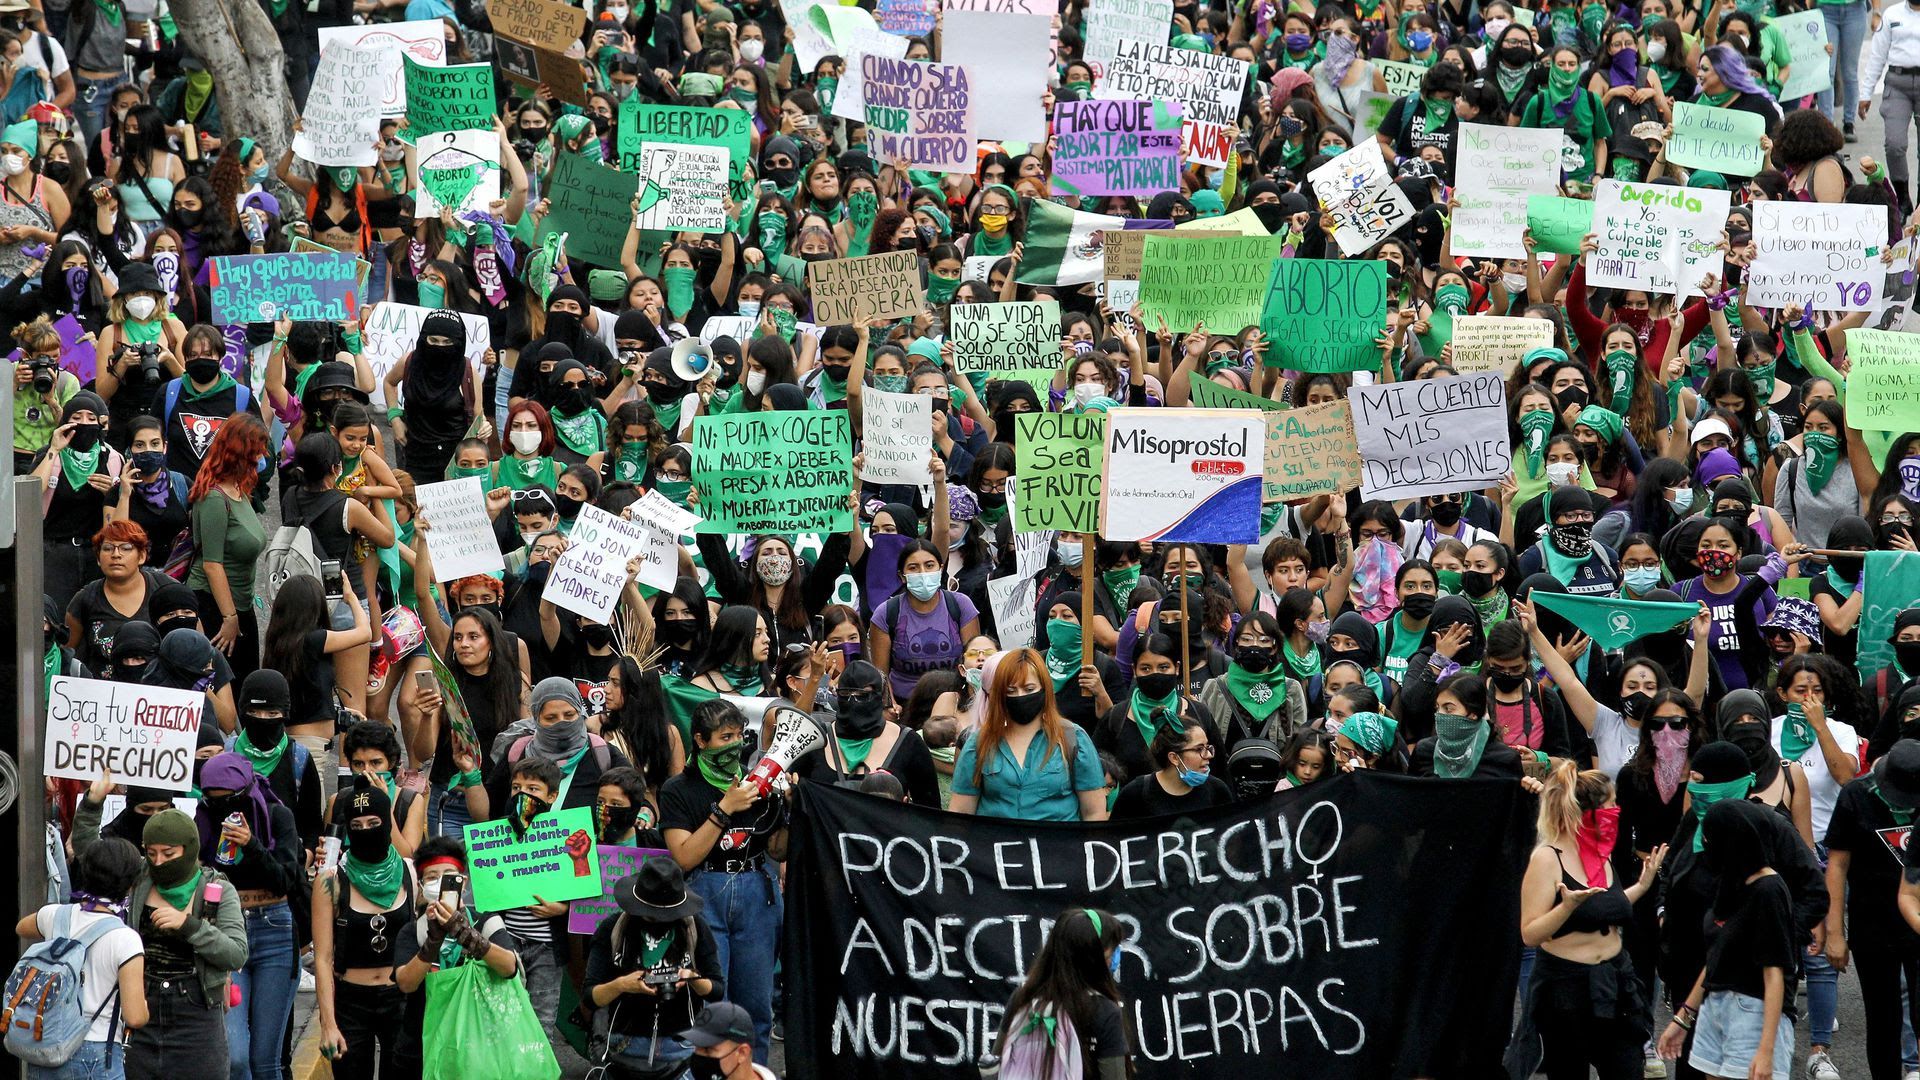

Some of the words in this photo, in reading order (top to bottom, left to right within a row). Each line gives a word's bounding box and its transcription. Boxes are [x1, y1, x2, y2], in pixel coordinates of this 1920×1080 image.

[506, 9, 540, 28] FRUTO
[546, 20, 558, 33] DE
[564, 26, 578, 38] TU
[553, 10, 575, 24] SEA
[508, 24, 556, 44] VIENTRE
[1117, 39, 1140, 60] LA
[1143, 42, 1200, 69] IGLESIA
[1203, 54, 1241, 75] LUCHA
[863, 54, 922, 88] CUANDO
[927, 64, 969, 92] SEA
[1112, 57, 1133, 73] POR
[1134, 63, 1151, 75] LA
[1204, 72, 1219, 88] DE
[1220, 74, 1242, 92] UN
[915, 88, 969, 110] QUIERO
[1108, 71, 1143, 93] FETO
[1145, 76, 1175, 97] PERO
[1177, 82, 1188, 99] SI
[1191, 84, 1221, 104] NACE
[636, 111, 729, 139] LIBERTAD
[864, 104, 910, 134] DECIDIR
[915, 111, 967, 135] SOBRE
[1056, 102, 1102, 134] HAY
[1104, 101, 1153, 133] QUE
[1680, 105, 1693, 127] Yo
[1700, 110, 1735, 133] decido
[882, 136, 897, 157] MI
[901, 137, 968, 165] CUERPO
[1055, 132, 1139, 160] ABORTAR
[1140, 135, 1174, 148] ESTE
[1464, 128, 1490, 151] No
[678, 163, 702, 172] SEXUAL
[1056, 161, 1105, 175] SISTEMA
[1104, 156, 1180, 190] PATRIARCAL
[1498, 156, 1535, 170] Todas
[433, 170, 471, 182] ABORTO
[667, 181, 729, 191] ANTICONCEPTIVOS
[670, 171, 712, 180] DECIDIR
[1486, 173, 1535, 186] Aborten
[669, 205, 701, 215] SEGURO
[704, 206, 723, 215] PARA
[671, 197, 706, 206] ABORTO
[1562, 199, 1588, 215] MI
[667, 216, 684, 227] NO
[687, 217, 723, 229] MORIR
[1344, 188, 1388, 241] ABUELA
[1606, 216, 1619, 228] No
[1624, 218, 1641, 231] te
[1759, 203, 1780, 232] Si
[1792, 215, 1816, 233] en
[1105, 233, 1122, 245] NO
[1106, 246, 1120, 254] NO
[1145, 241, 1160, 259] EN
[1165, 242, 1180, 262] UN
[1213, 241, 1228, 260] EN
[1246, 239, 1272, 259] QUE
[1608, 229, 1663, 249] Culpable
[1761, 235, 1806, 254] Utero
[1811, 238, 1862, 252] manda
[1617, 248, 1640, 260] que
[1645, 251, 1660, 261] es
[1826, 252, 1868, 272] Dios
[291, 253, 357, 282] abortar
[813, 262, 835, 282] LA
[840, 252, 918, 280] MATERNIDAD
[1144, 264, 1180, 285] TANTAS
[1186, 264, 1224, 285] MADRES
[1229, 263, 1265, 284] SOLAS
[1752, 273, 1774, 286] en
[1780, 271, 1796, 286] el
[1800, 273, 1832, 285] mio
[236, 283, 317, 308] sistema
[1264, 260, 1381, 319] ABORTO
[1760, 290, 1828, 304] mando
[1836, 281, 1872, 307] YO
[371, 306, 407, 335] UNA
[817, 301, 831, 322] O
[836, 297, 858, 320] NO
[1003, 305, 1044, 324] VIDA
[1174, 309, 1217, 329] HOMBRES
[954, 322, 980, 342] NO
[986, 322, 1008, 343] SE
[1015, 323, 1062, 343] SALVA
[1322, 320, 1381, 344] SEGURO
[956, 341, 993, 355] SOLO
[1006, 342, 1040, 356] CON
[957, 355, 1017, 371] DEJARLA
[863, 392, 888, 414] UNA
[894, 400, 920, 414] VIDA
[1361, 387, 1410, 426] MI
[1418, 375, 1502, 413] CUERPO
[1867, 392, 1882, 402] EN
[1885, 392, 1910, 401] VIDA
[700, 424, 717, 450] Ni
[724, 420, 769, 447] PUTA
[782, 415, 849, 447] COGER
[868, 412, 882, 428] NO
[891, 417, 904, 430] SE
[867, 429, 896, 447] SALVA
[900, 434, 929, 447] SOLO
[1111, 427, 1248, 464] Misoprostol
[1383, 417, 1441, 451] MIS
[697, 454, 712, 474] Ni
[720, 451, 772, 472] MADRE
[788, 450, 844, 469] DEBER
[864, 446, 918, 462] DEJANDOLA
[1030, 446, 1092, 471] Sea
[1366, 441, 1510, 489] DECISIONES
[865, 464, 899, 478] NACER
[1195, 460, 1240, 474] Tabletas
[699, 480, 712, 498] Ni
[721, 475, 769, 496] PRESA
[784, 470, 850, 492] ABORTAR
[1021, 474, 1102, 501] FRUTO
[723, 499, 777, 520] MUERTA
[786, 495, 850, 517] INTENTAR
[1021, 503, 1054, 528] tu
[583, 506, 606, 524] LAS
[607, 516, 642, 541] NIÑAS
[574, 521, 598, 543] NO
[600, 537, 631, 559] SON
[582, 550, 603, 566] NO
[559, 554, 599, 581] DEBEN
[601, 572, 623, 589] SER
[550, 571, 610, 610] MADRES
[1712, 604, 1735, 621] JUS
[1719, 620, 1737, 635] TI
[52, 680, 98, 723] Saca
[105, 686, 128, 724] tu
[134, 697, 201, 733] RELIGIÓN
[94, 723, 108, 742] DE
[119, 726, 148, 745] MIS
[796, 733, 809, 744] EL
[54, 740, 188, 783] DERECHOS
[531, 816, 558, 830] una
[838, 832, 974, 896] POR
[994, 837, 1067, 891] EL
[1084, 800, 1343, 892] DERECHO
[474, 855, 498, 869] que
[502, 851, 528, 864] una
[511, 861, 561, 878] muerta
[840, 917, 895, 976] A
[1166, 875, 1380, 983] SOBRE
[1121, 977, 1366, 1062] UERPAS
